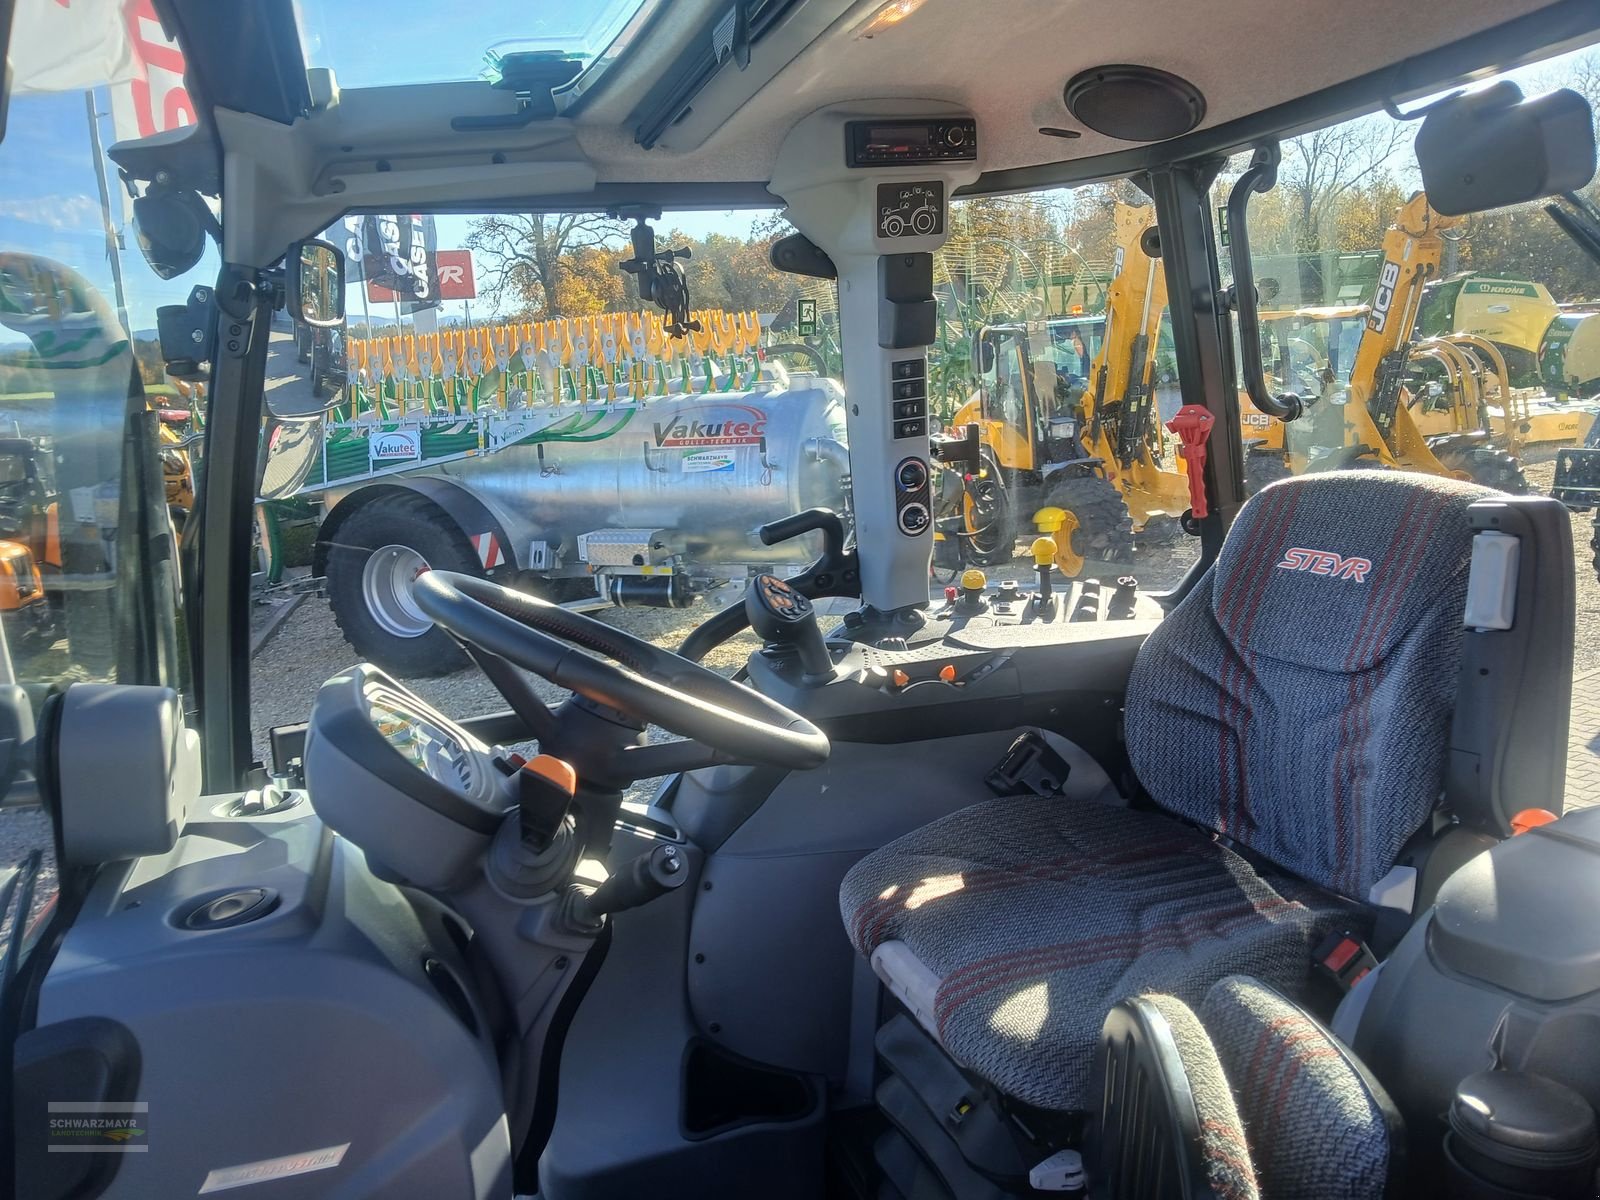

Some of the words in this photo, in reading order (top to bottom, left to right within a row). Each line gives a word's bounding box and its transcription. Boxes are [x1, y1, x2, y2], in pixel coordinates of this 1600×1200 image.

[1372, 263, 1399, 332] JCB
[1490, 286, 1526, 295] KRONE
[1242, 414, 1269, 425] JCB
[653, 416, 767, 448] Vakutec
[374, 442, 415, 457] Vakutec
[1277, 548, 1372, 583] STEYR
